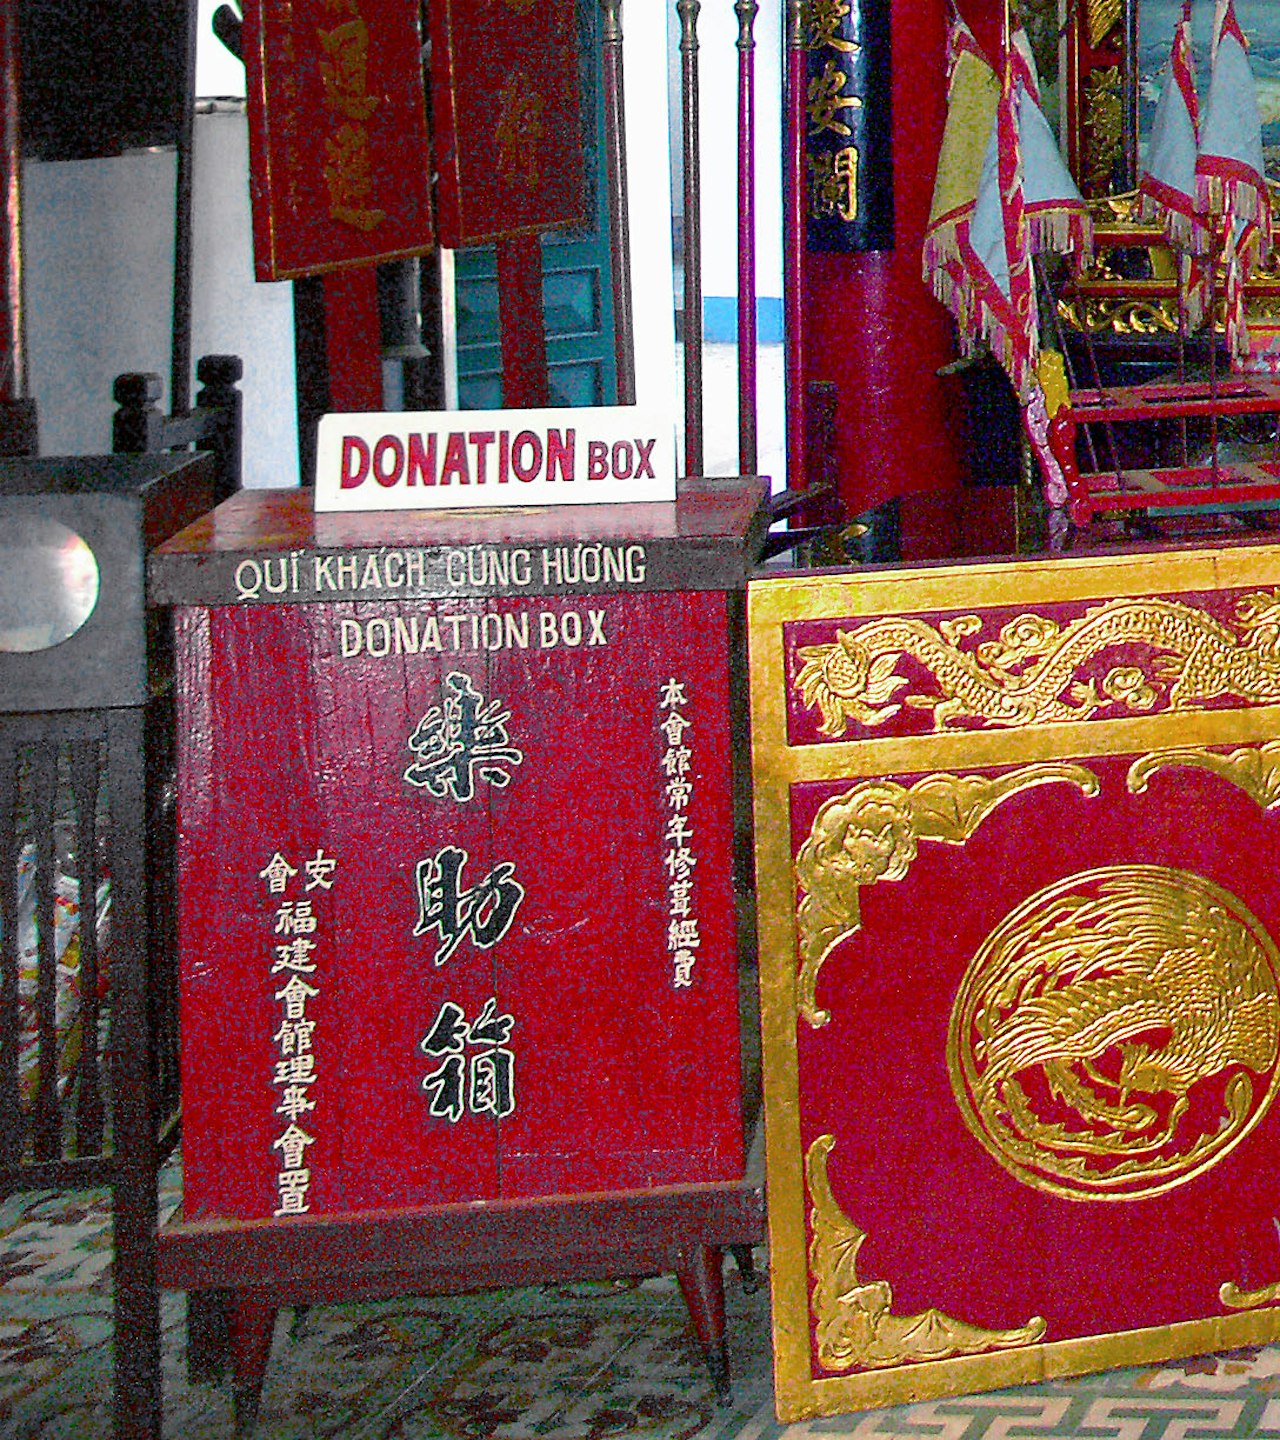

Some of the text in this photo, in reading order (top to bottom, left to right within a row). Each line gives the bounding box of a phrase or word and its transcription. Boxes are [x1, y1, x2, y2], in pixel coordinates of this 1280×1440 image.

[340, 428, 657, 490] DONATION BOX
[314, 546, 426, 593] KHÁCH
[340, 608, 609, 660] DONATION BOX
[404, 670, 525, 1122] 樂助箱
